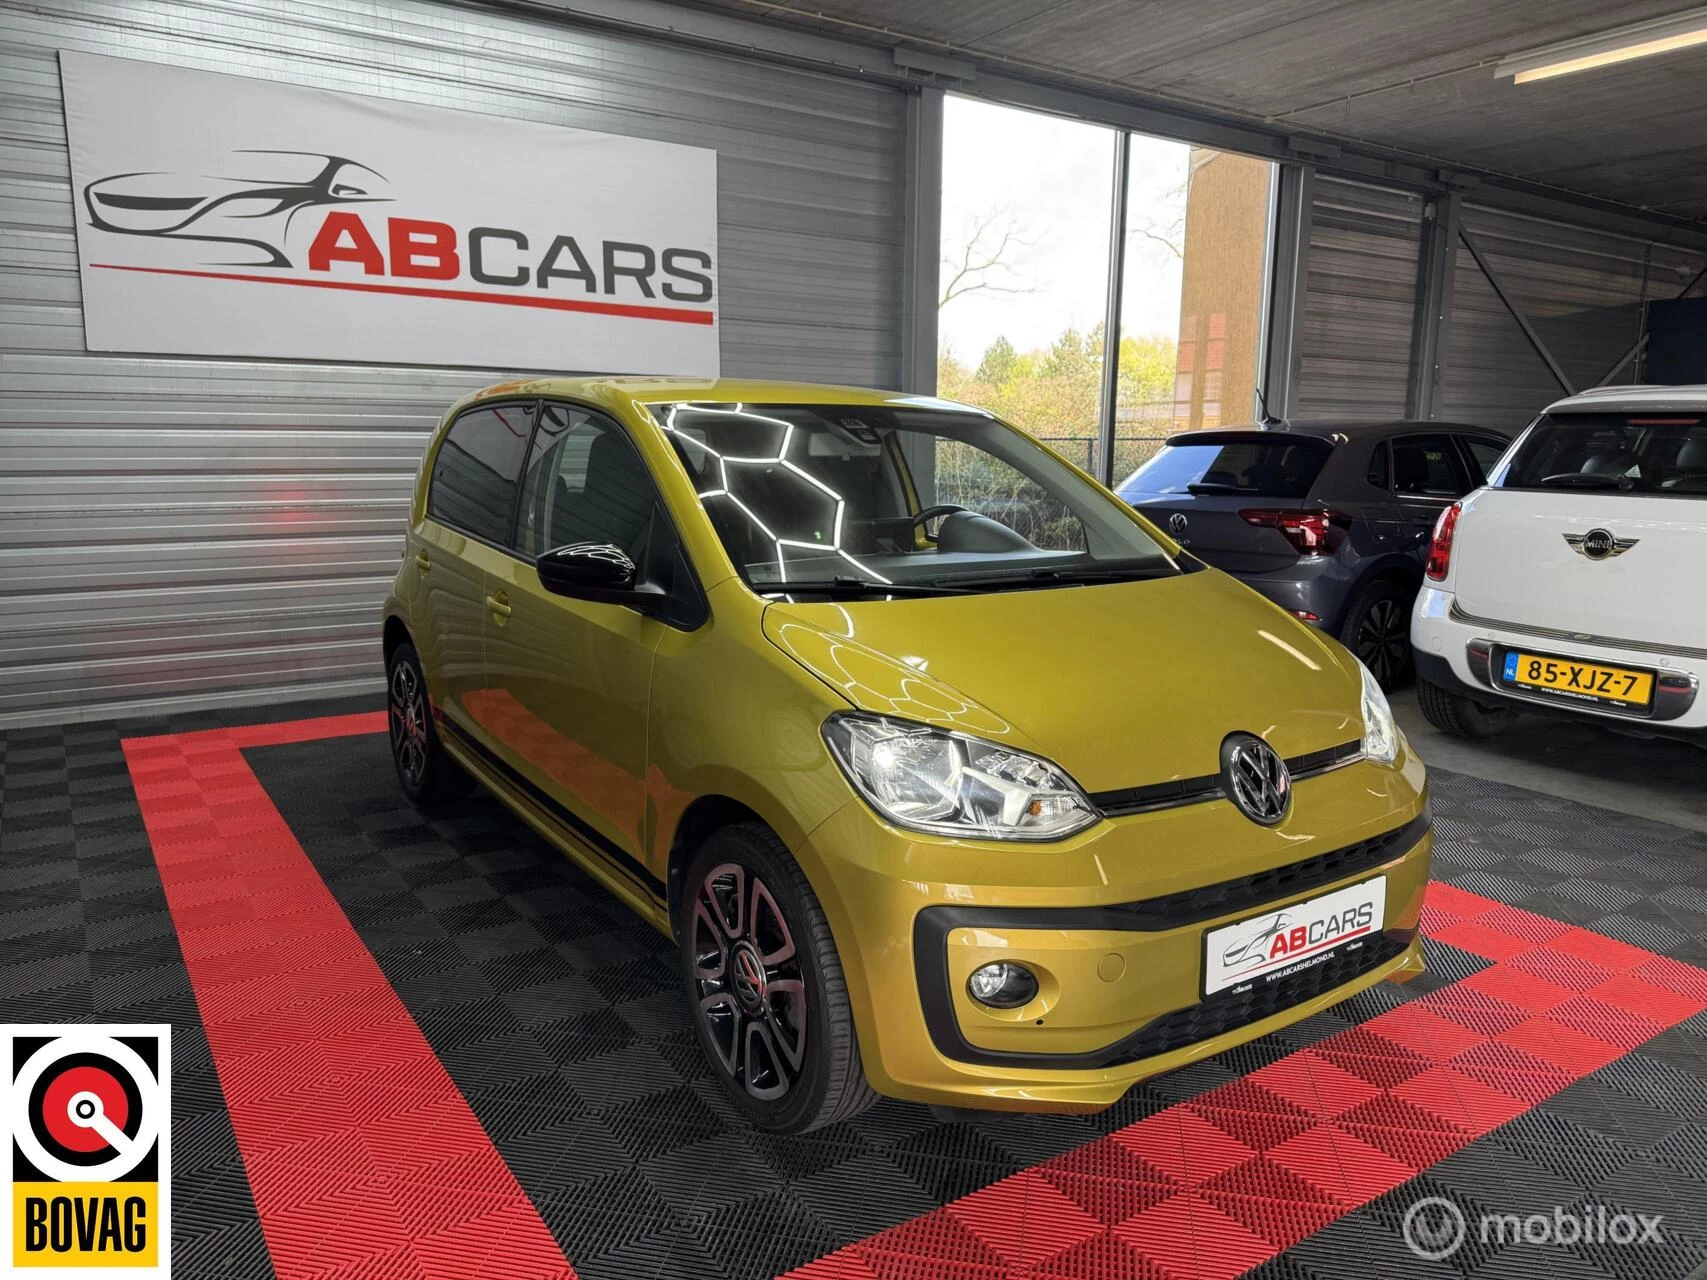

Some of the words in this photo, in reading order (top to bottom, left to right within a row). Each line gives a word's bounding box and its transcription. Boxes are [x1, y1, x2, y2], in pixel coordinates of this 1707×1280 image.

[307, 210, 713, 304] ABCARS
[1585, 538, 1612, 550] MINI
[1505, 667, 1516, 677] NL
[1527, 660, 1639, 696] 85-XJZ-7
[1269, 901, 1374, 960] ABCARS
[1265, 951, 1336, 983] WWW.ABCARSHELMOND.NL
